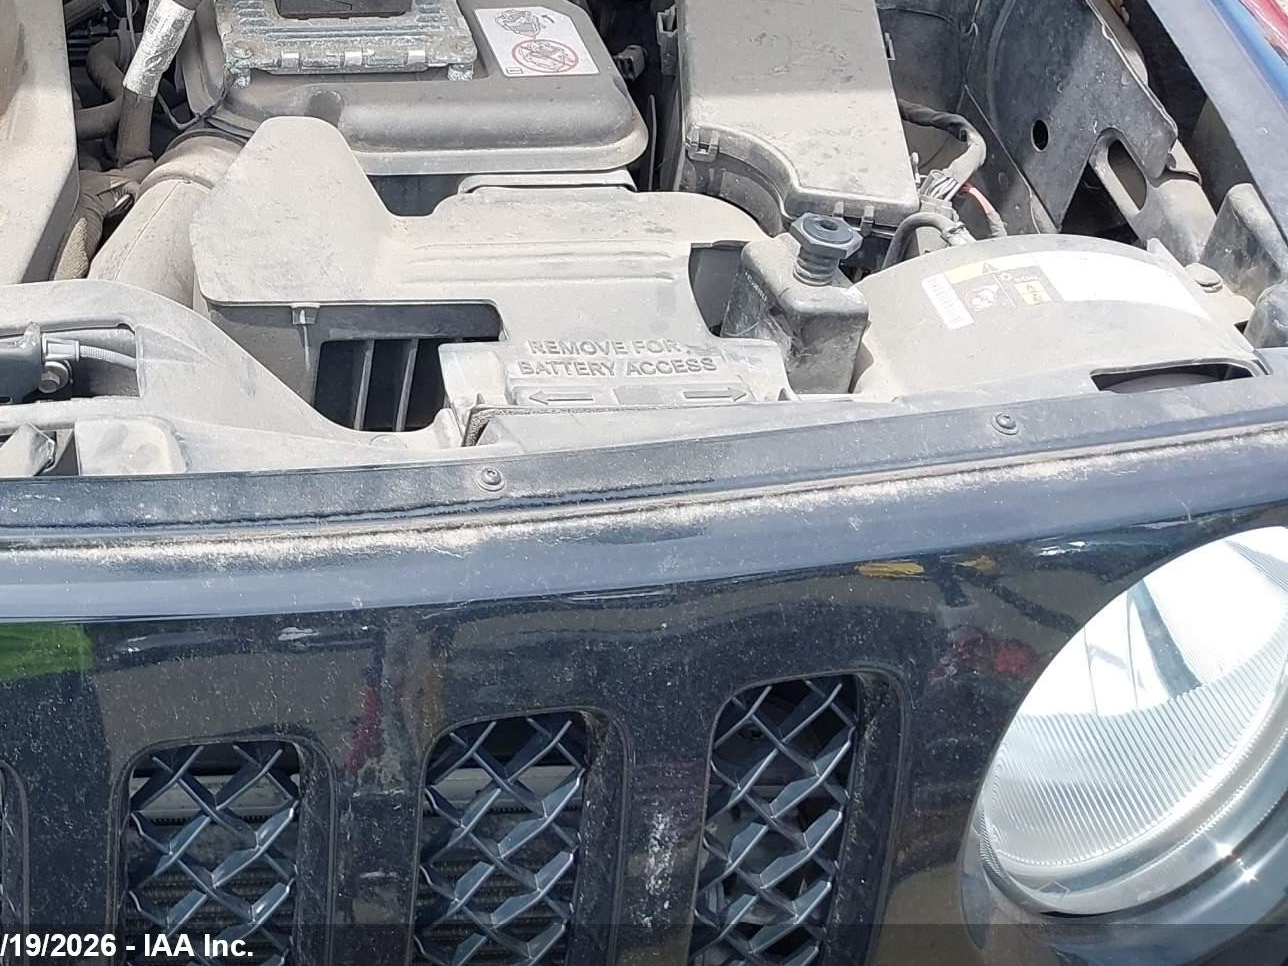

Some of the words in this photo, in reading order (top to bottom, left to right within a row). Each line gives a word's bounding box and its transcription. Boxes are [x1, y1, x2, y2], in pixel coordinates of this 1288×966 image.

[528, 339, 628, 356] REMOVE
[631, 338, 681, 355] FOR
[517, 360, 616, 376] BATTERY
[625, 356, 718, 376] ACCESS
